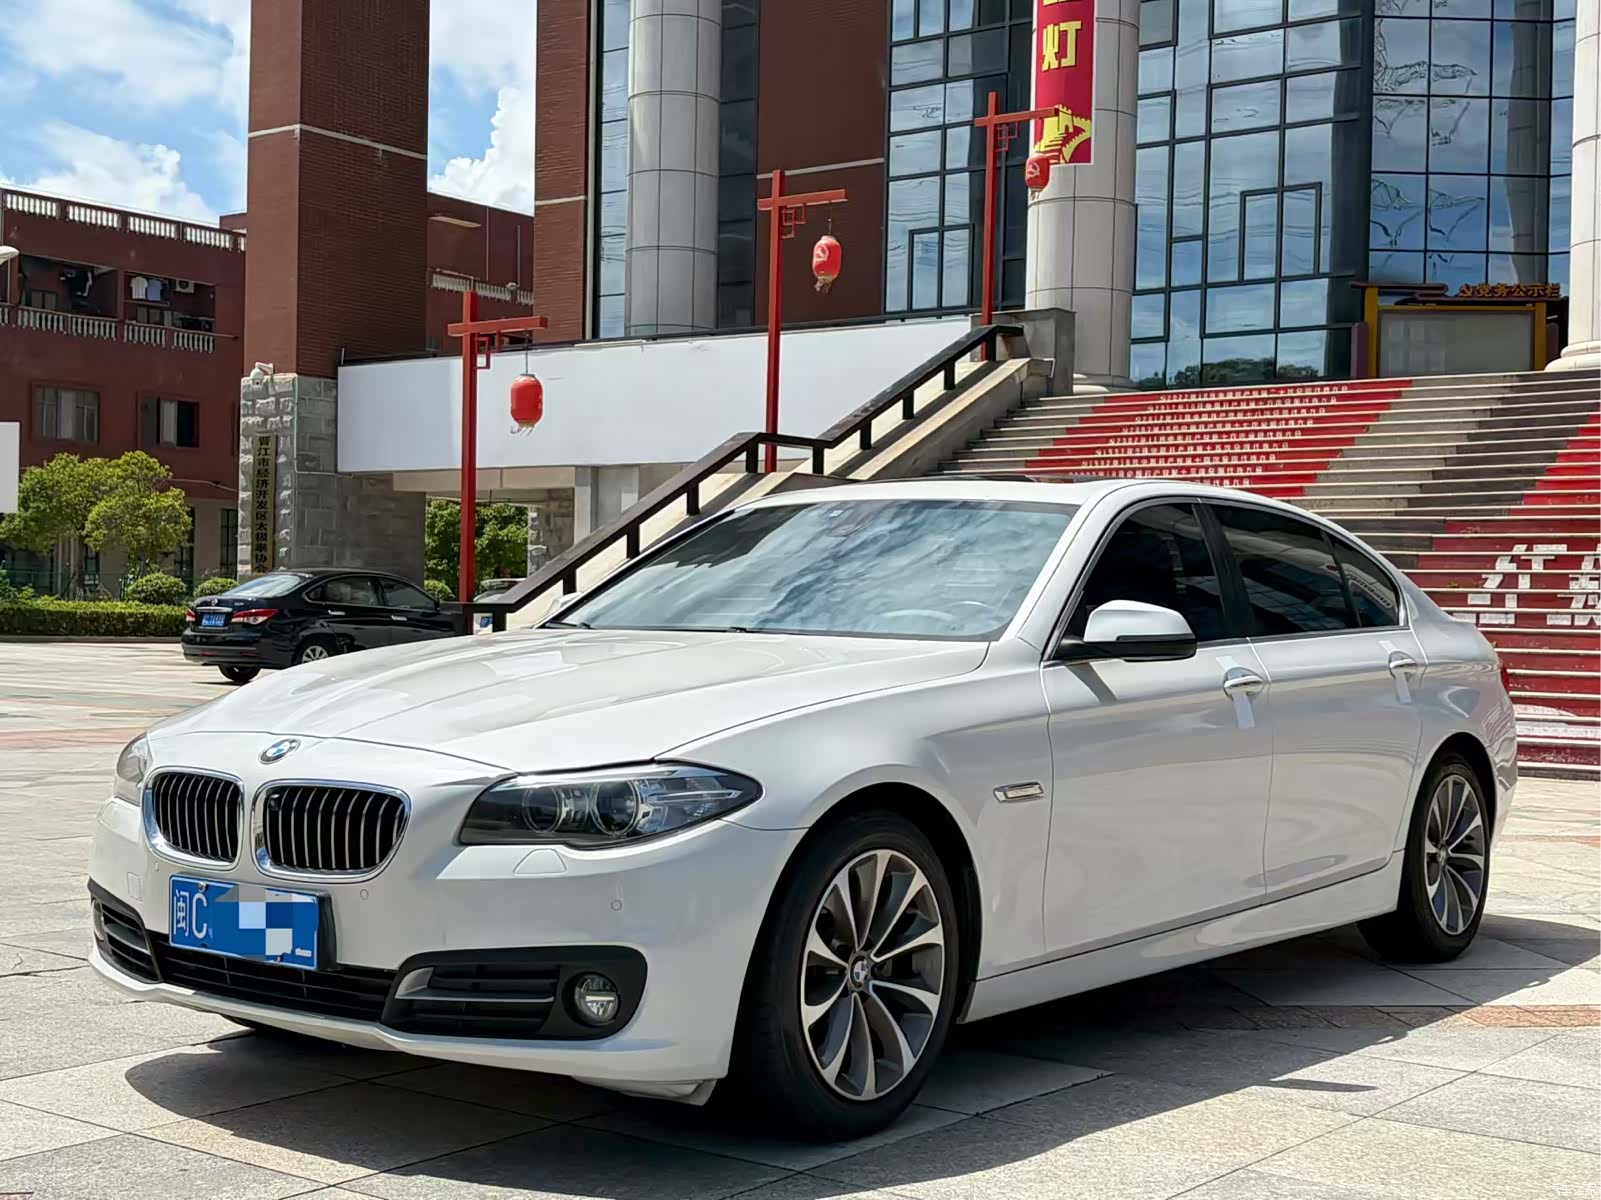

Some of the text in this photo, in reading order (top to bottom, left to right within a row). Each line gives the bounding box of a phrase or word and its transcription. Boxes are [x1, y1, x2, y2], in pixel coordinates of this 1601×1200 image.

[1041, 0, 1082, 72] 灯
[1476, 283, 1560, 298] 党务公示栏
[174, 889, 208, 939] 闽C
